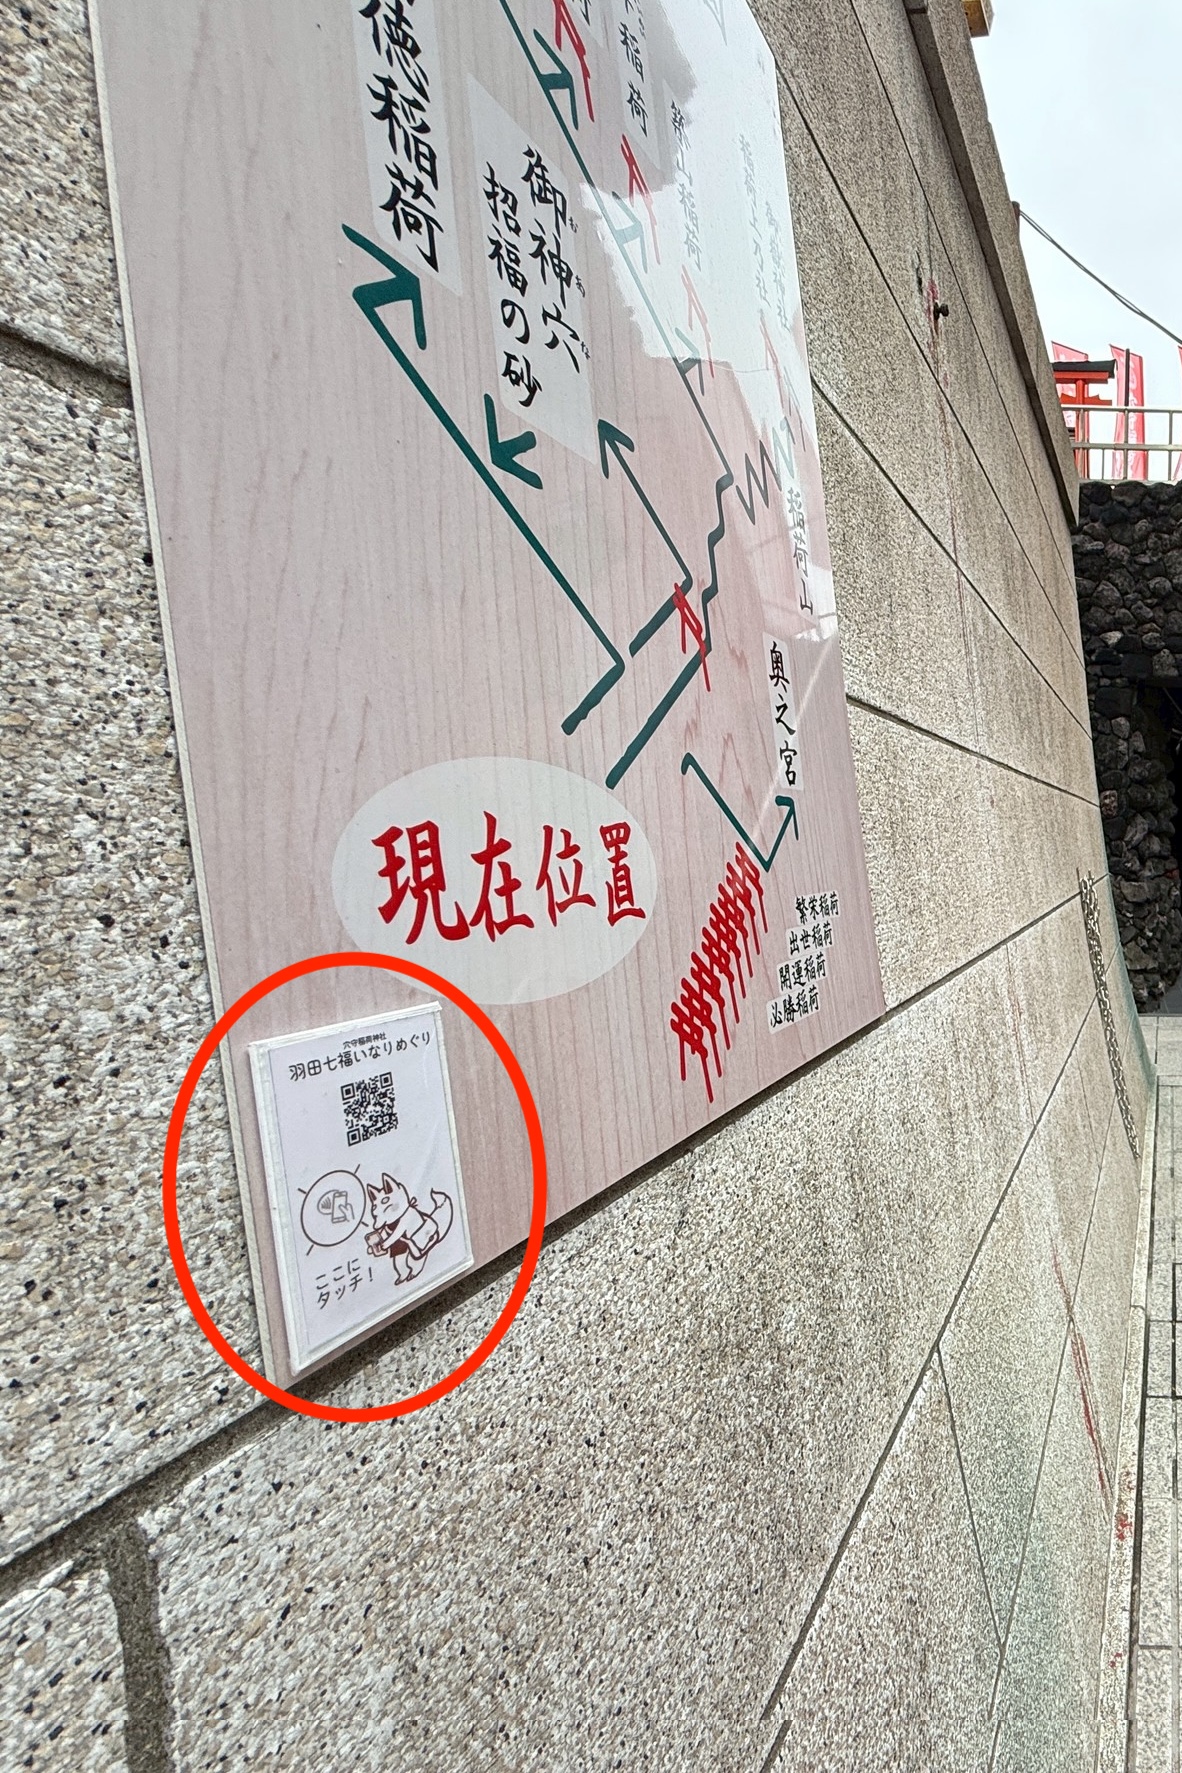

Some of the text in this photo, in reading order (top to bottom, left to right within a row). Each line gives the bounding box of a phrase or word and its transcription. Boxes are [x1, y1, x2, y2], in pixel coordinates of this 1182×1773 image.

[522, 146, 580, 373] 御神穴
[483, 162, 541, 407] 招福の砂
[787, 487, 814, 616] 稲荷山
[768, 641, 798, 786] 奥之宮
[371, 810, 647, 945] 現在位置
[795, 891, 839, 926] 繁栄稲荷
[789, 920, 833, 956] 出世稲荷
[778, 951, 826, 992] 開運稲荷
[770, 984, 819, 1028] 必勝稲荷
[288, 1031, 431, 1081] 羽田七福いなりめぐり
[342, 1032, 388, 1050] 穴守稲荷神社
[316, 1258, 361, 1290] ここに
